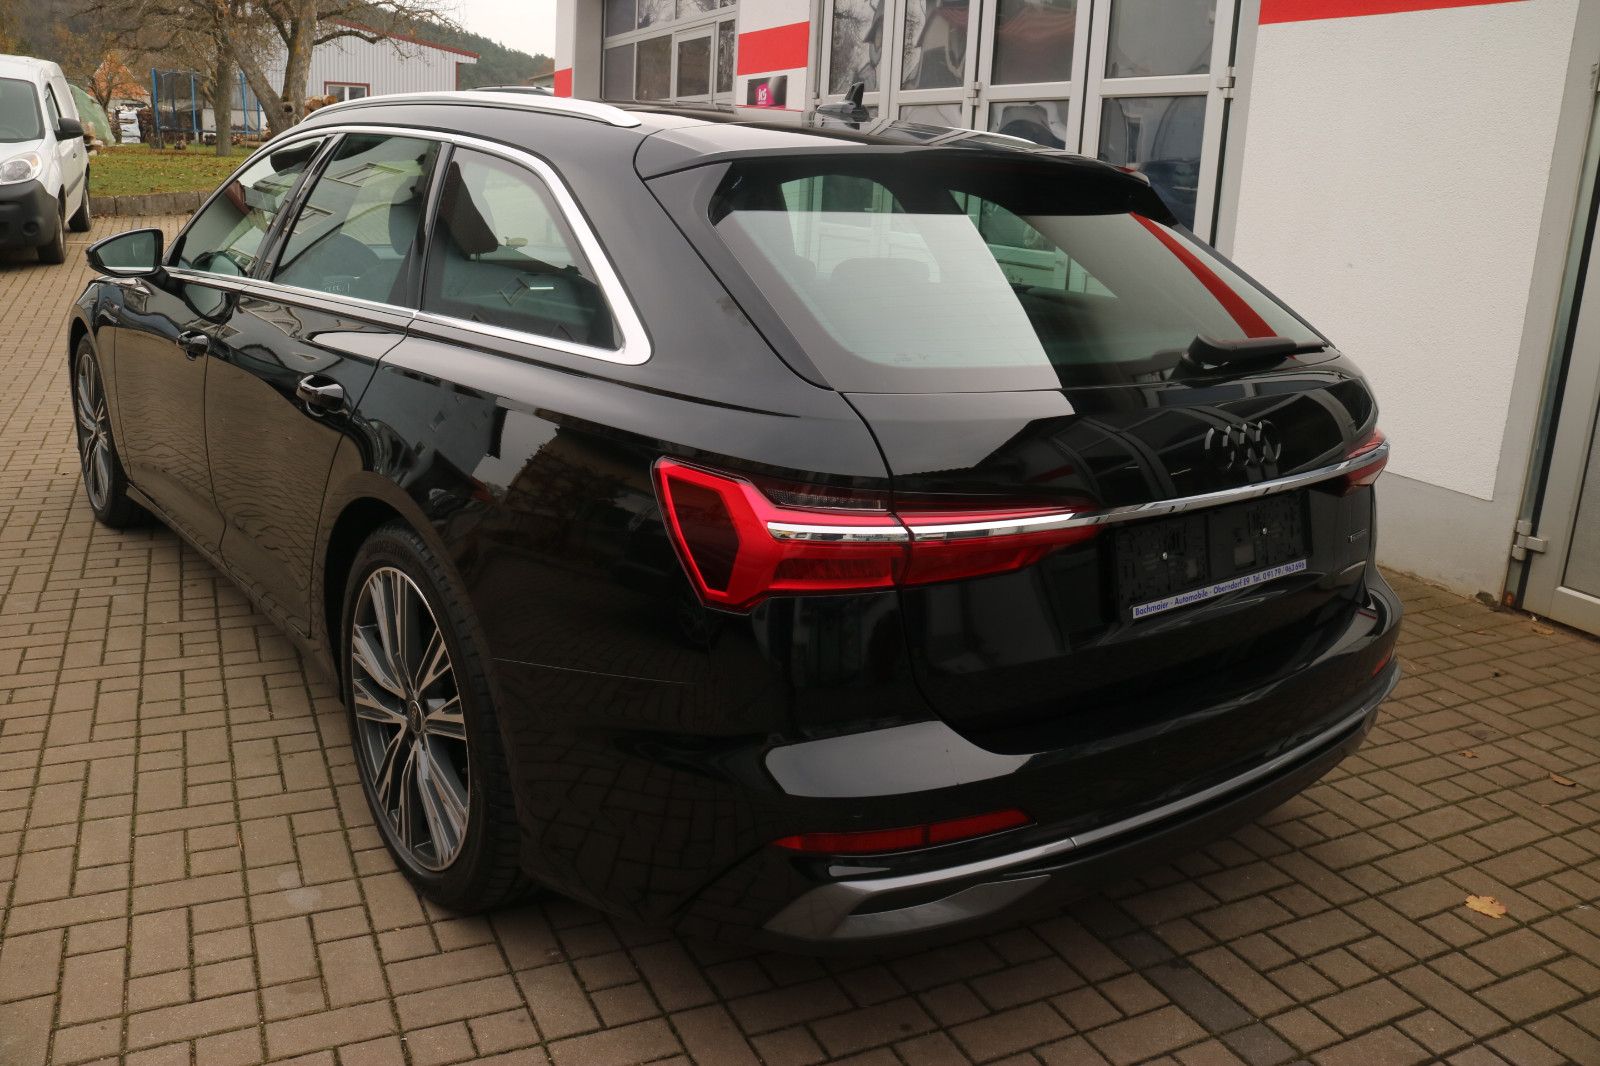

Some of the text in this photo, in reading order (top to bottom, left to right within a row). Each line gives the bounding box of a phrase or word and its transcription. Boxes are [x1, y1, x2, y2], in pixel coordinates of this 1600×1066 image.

[1135, 602, 1169, 616] Bachmaier
[1174, 589, 1208, 605] Automobile
[1213, 580, 1242, 594] Oberndorf
